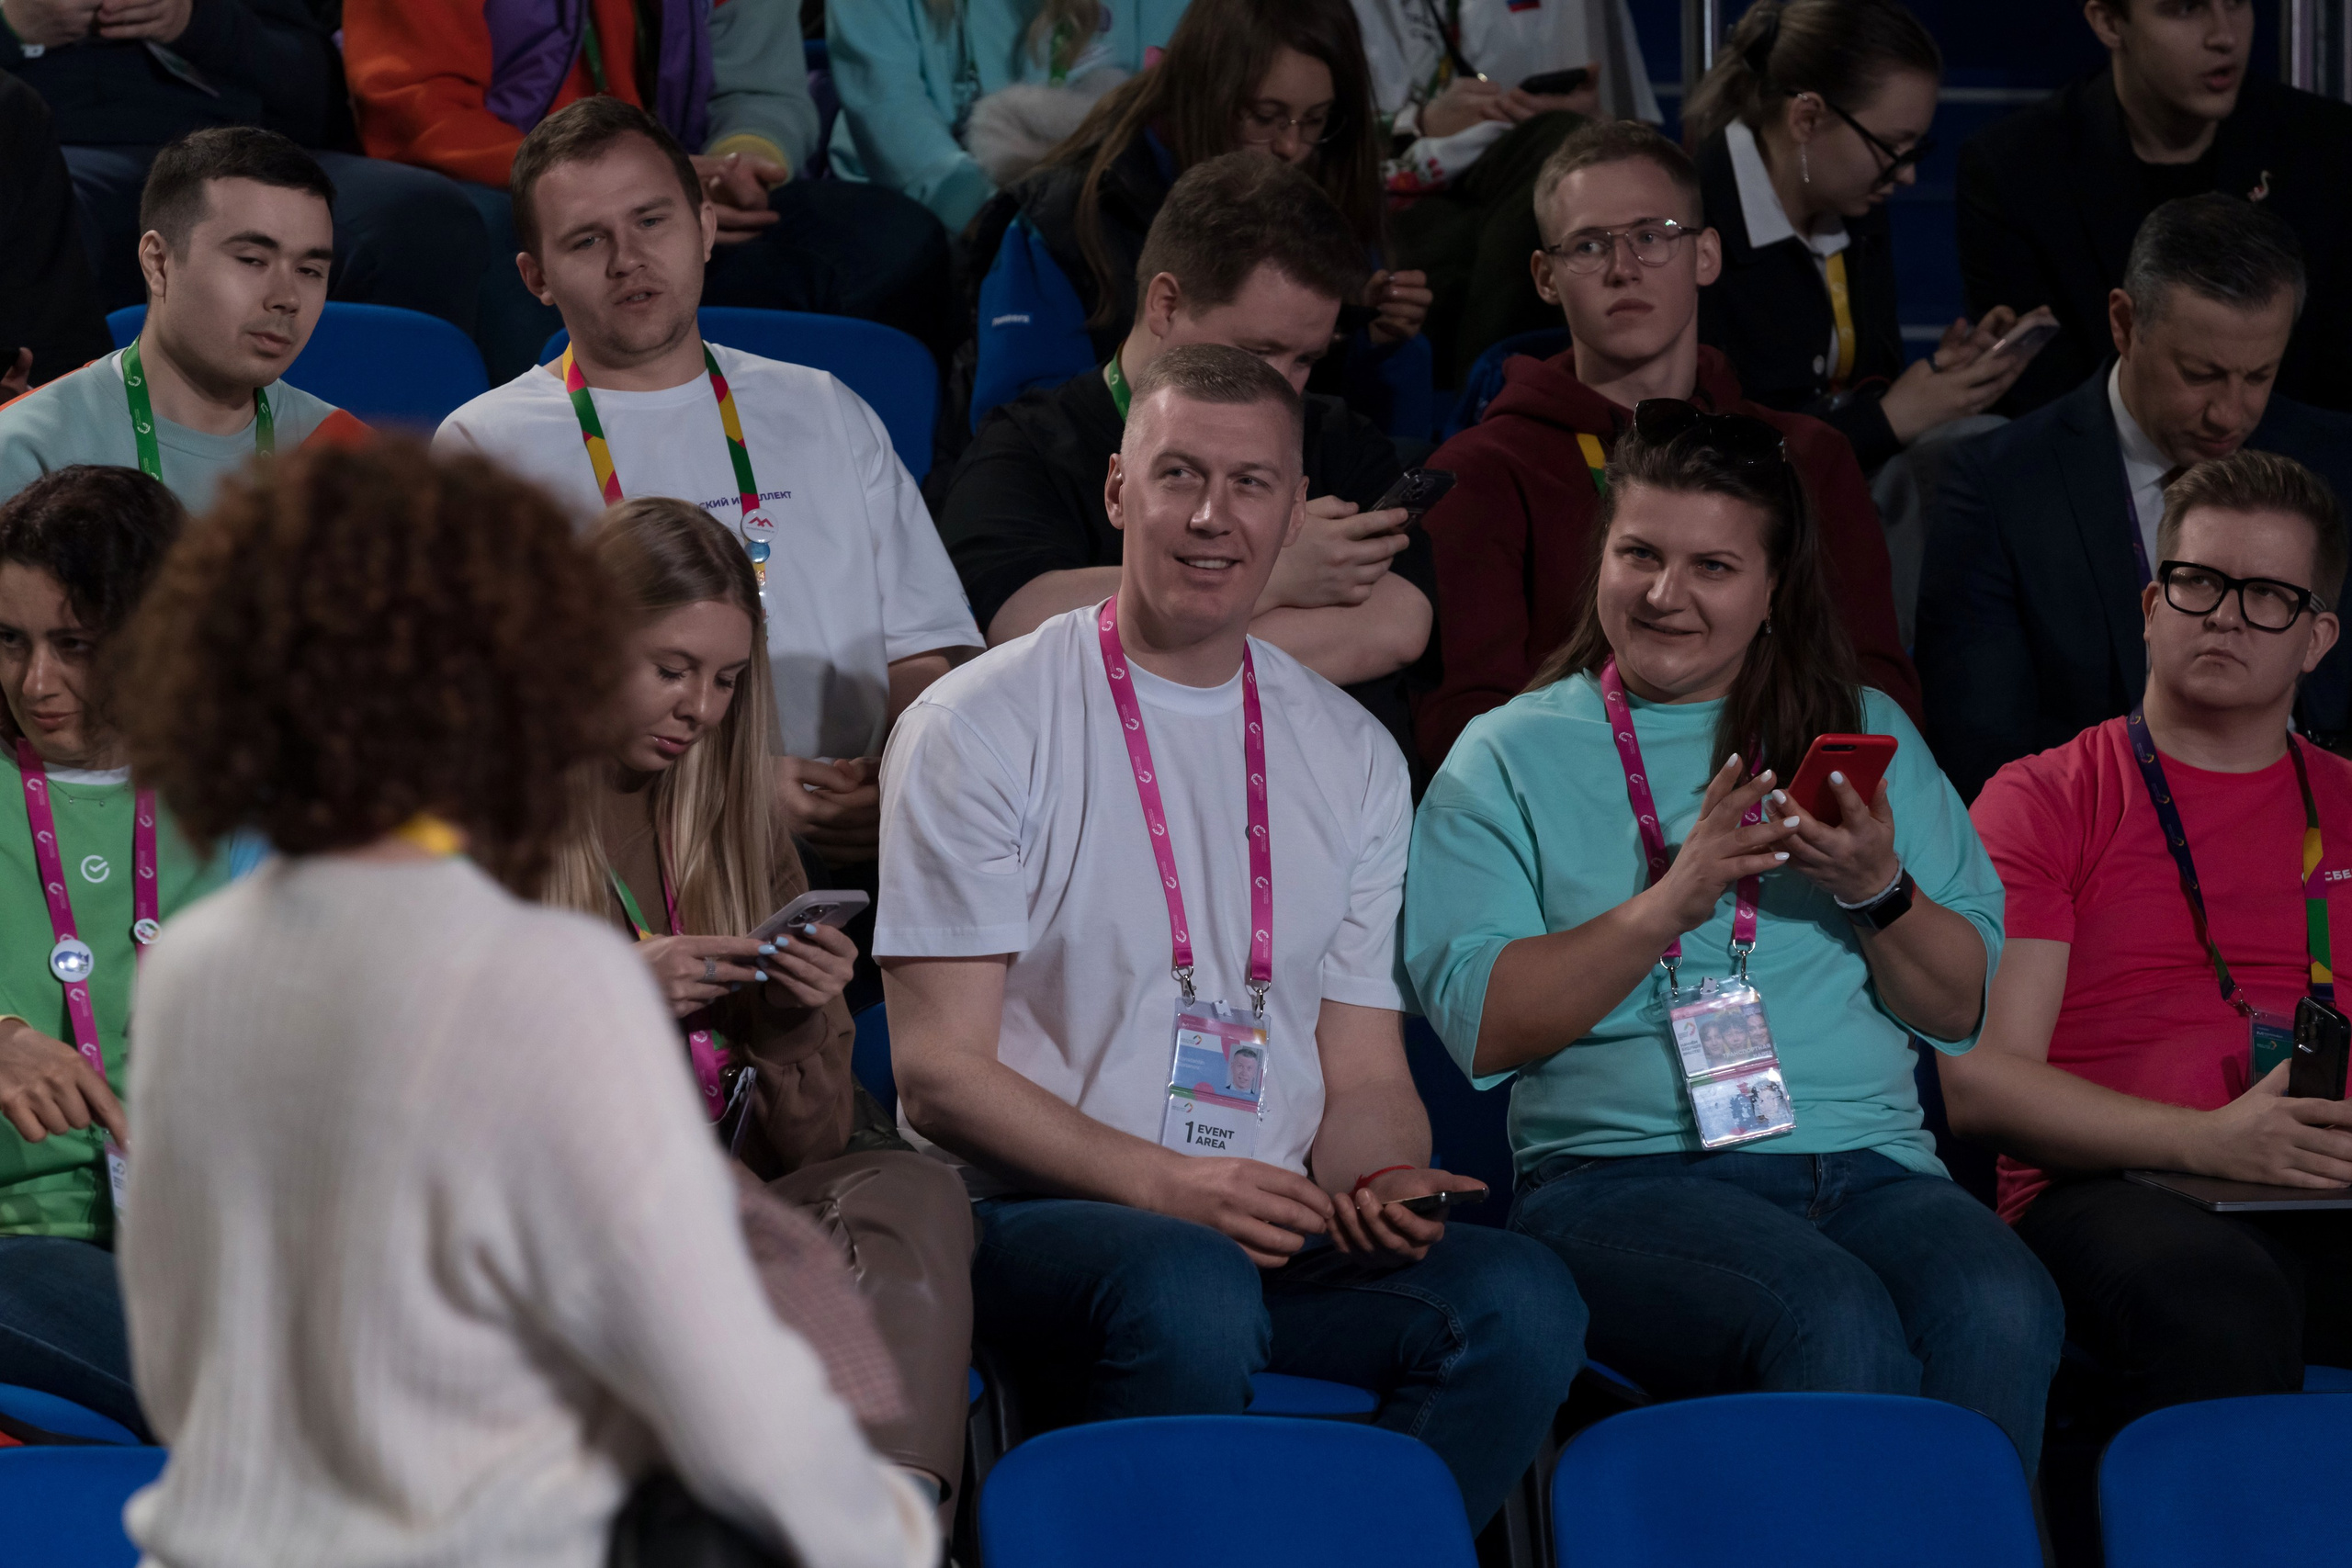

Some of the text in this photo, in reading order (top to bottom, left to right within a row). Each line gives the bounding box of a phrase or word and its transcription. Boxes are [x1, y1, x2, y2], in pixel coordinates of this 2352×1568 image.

[731, 491, 792, 505] ИЛЛЕКТ
[2324, 868, 2352, 881] СБЕ
[1185, 1121, 1235, 1144] 1 EVENT
[1195, 1135, 1227, 1150] AREA
